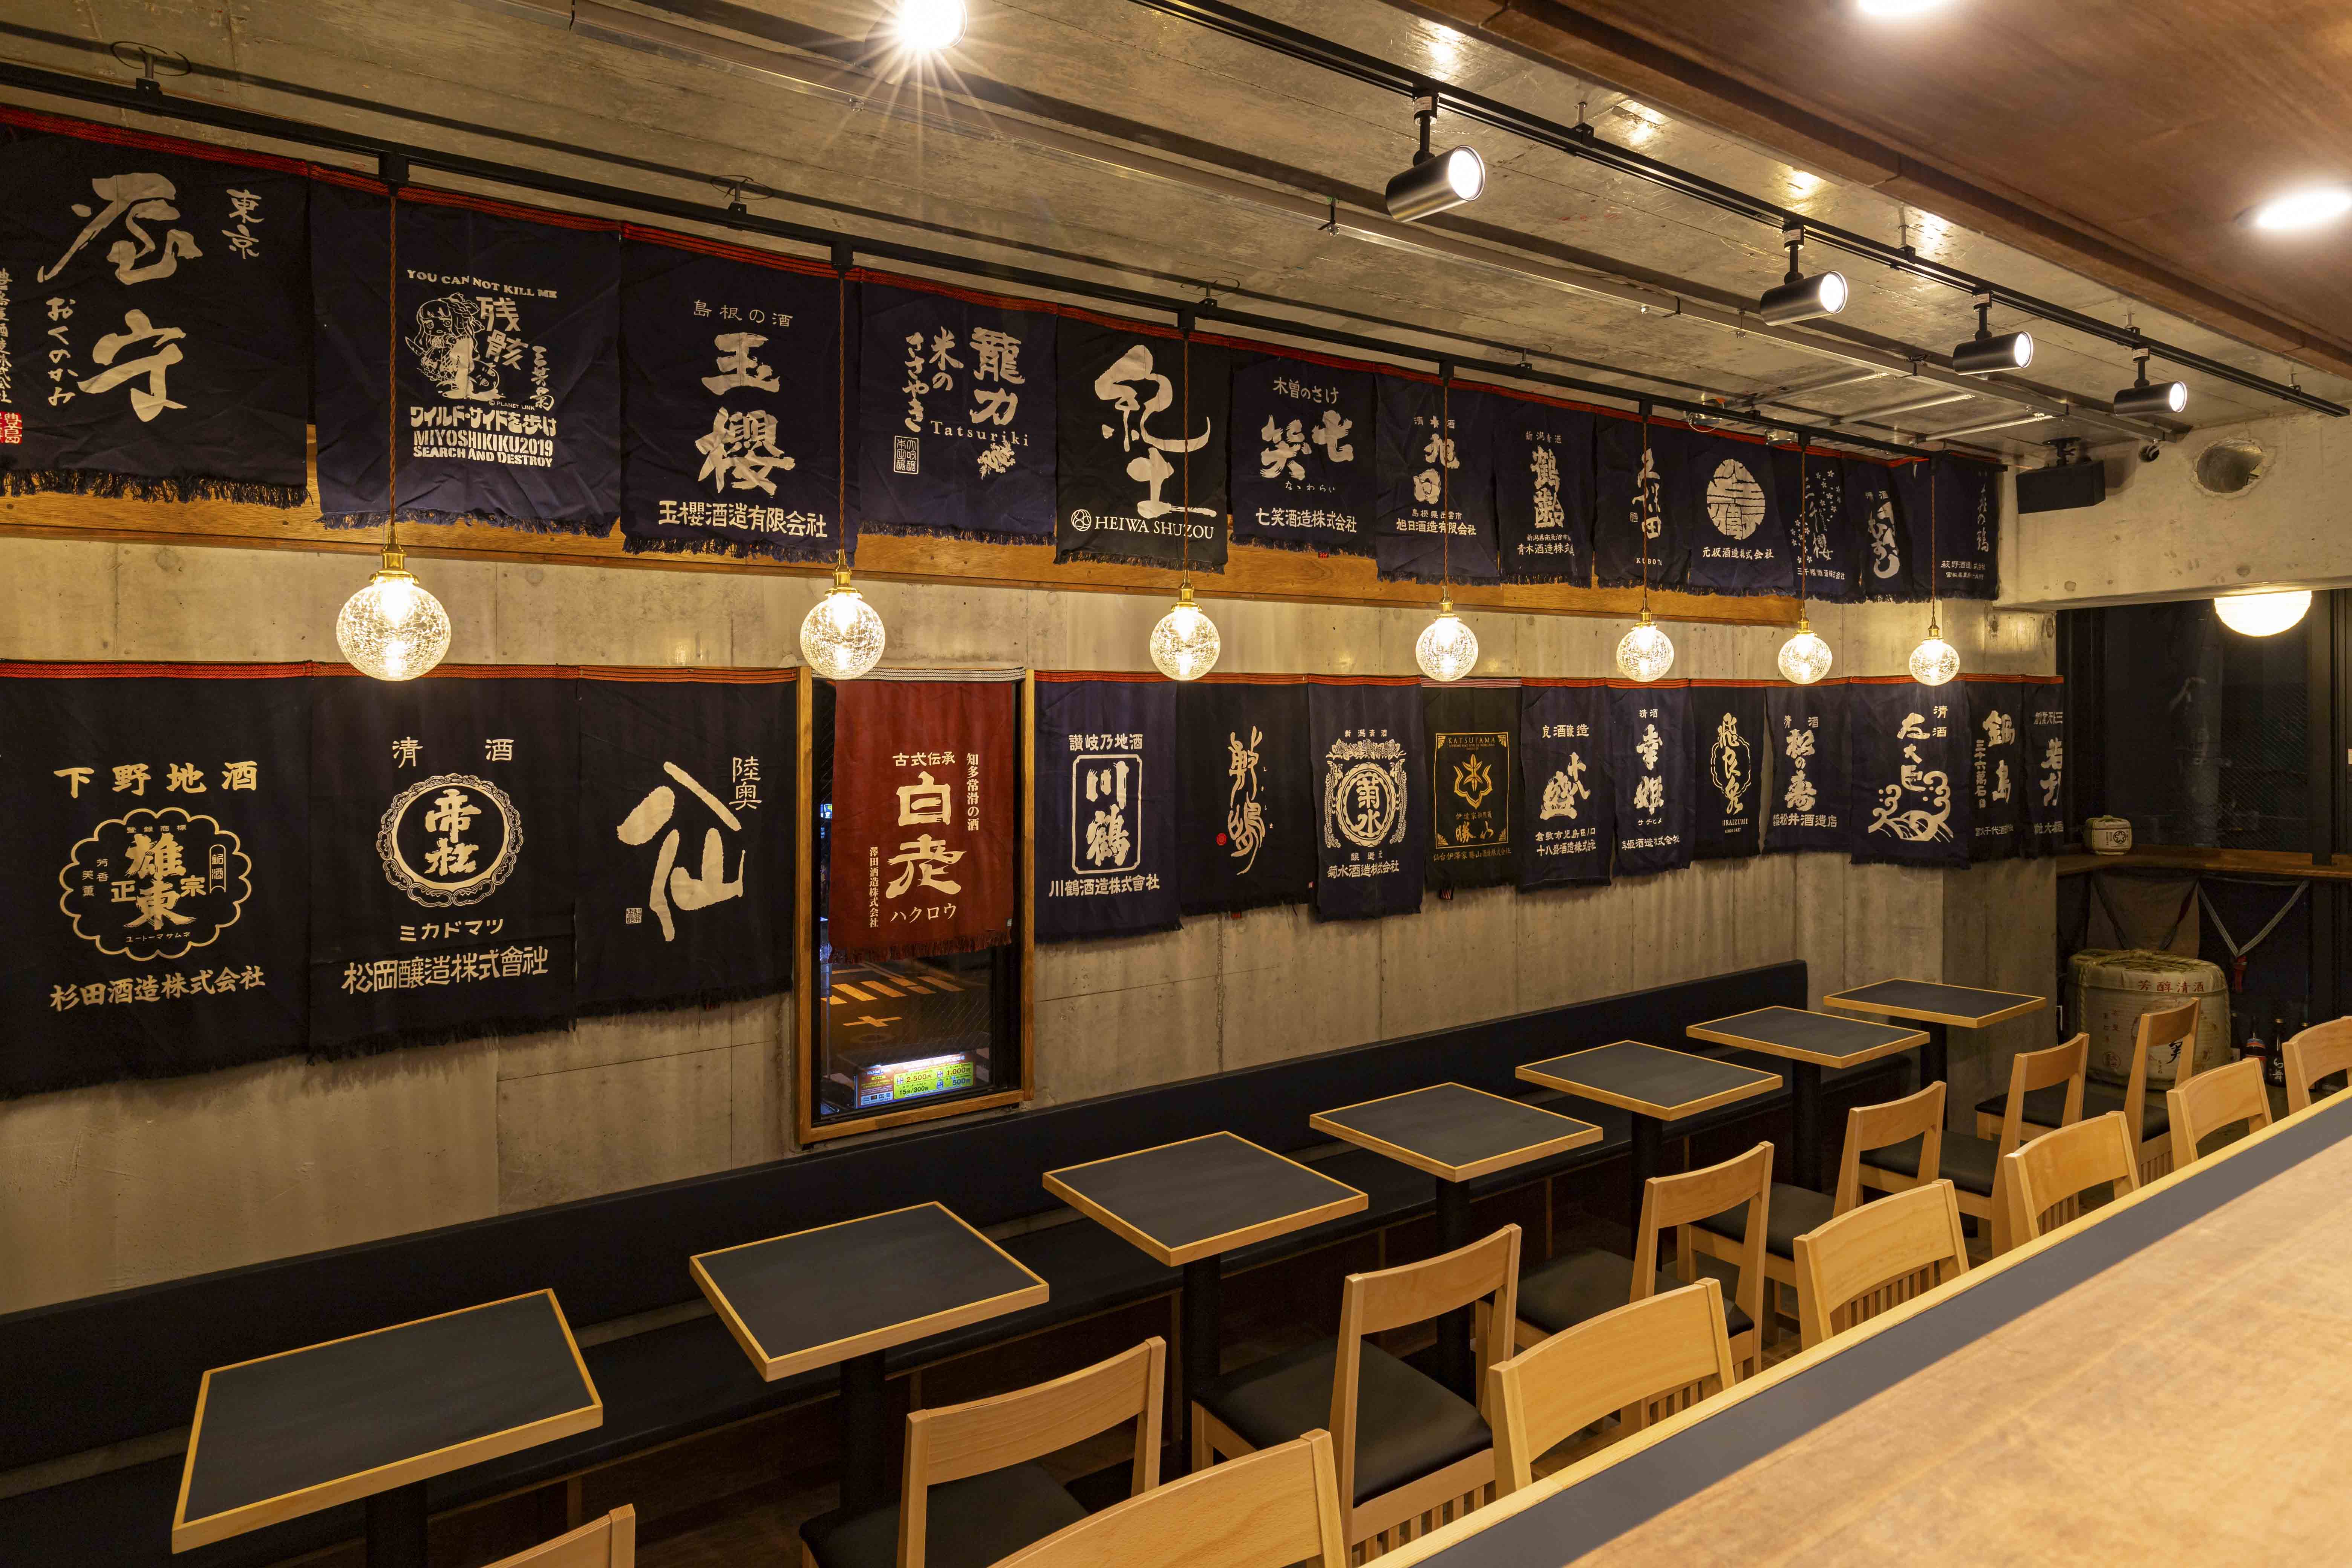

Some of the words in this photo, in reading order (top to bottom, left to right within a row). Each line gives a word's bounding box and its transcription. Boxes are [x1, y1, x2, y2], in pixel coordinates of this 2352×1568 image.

[222, 189, 265, 259] 東京
[407, 270, 437, 282] YOU
[441, 276, 470, 285] CAN
[473, 277, 500, 291] NOT
[503, 285, 535, 297] KILL
[537, 289, 557, 299] ME
[693, 299, 793, 327] 島根の酒
[476, 296, 529, 371] 残骸
[46, 297, 78, 406] おくのかみ
[929, 326, 964, 391] 米の
[902, 332, 929, 432] ささやき
[969, 327, 1025, 426] 龍力
[1272, 377, 1339, 404] 木曽のさけ
[930, 421, 1029, 446] Tatsuriki
[1414, 416, 1455, 429] 清酒
[413, 446, 466, 459] SEARCH
[468, 447, 495, 462] AND
[497, 451, 553, 467] DESTROY
[414, 429, 554, 457] MIYOSHIKIKU2019
[1260, 410, 1354, 481] 七笑
[1094, 516, 1150, 533] HEIWA
[1153, 521, 1214, 539] SHUZOU
[1256, 507, 1357, 533] 七笑酒造株式会社
[1396, 518, 1477, 536] 旭日酒造有限会社
[1411, 508, 1462, 520] 島根県出雲市
[1702, 547, 1774, 560] 元坂酒造株式会社
[1639, 709, 1658, 718] 清酒
[1784, 715, 1819, 728] 清酒
[1932, 705, 1948, 738] 清酒
[1345, 729, 1387, 738] 新潟清酒
[392, 736, 514, 768] 清酒
[892, 751, 956, 767] 古式伝承
[54, 760, 258, 798] 下野地酒
[729, 756, 762, 810] 陸奥
[966, 753, 979, 831] 知多常滑の酒
[1086, 761, 1130, 866] 川鶴
[1354, 777, 1383, 834] 菊水
[126, 825, 187, 833] 登録商標
[1327, 860, 1400, 879] 菊水酒造株式会社
[869, 846, 879, 928] 澤田酒造株式会社
[890, 903, 957, 923] ハクロウ
[400, 919, 504, 942] ミカドマツ
[49, 965, 266, 1012] 杉田酒造株式会社
[2138, 980, 2205, 994] 芳醇清酒
